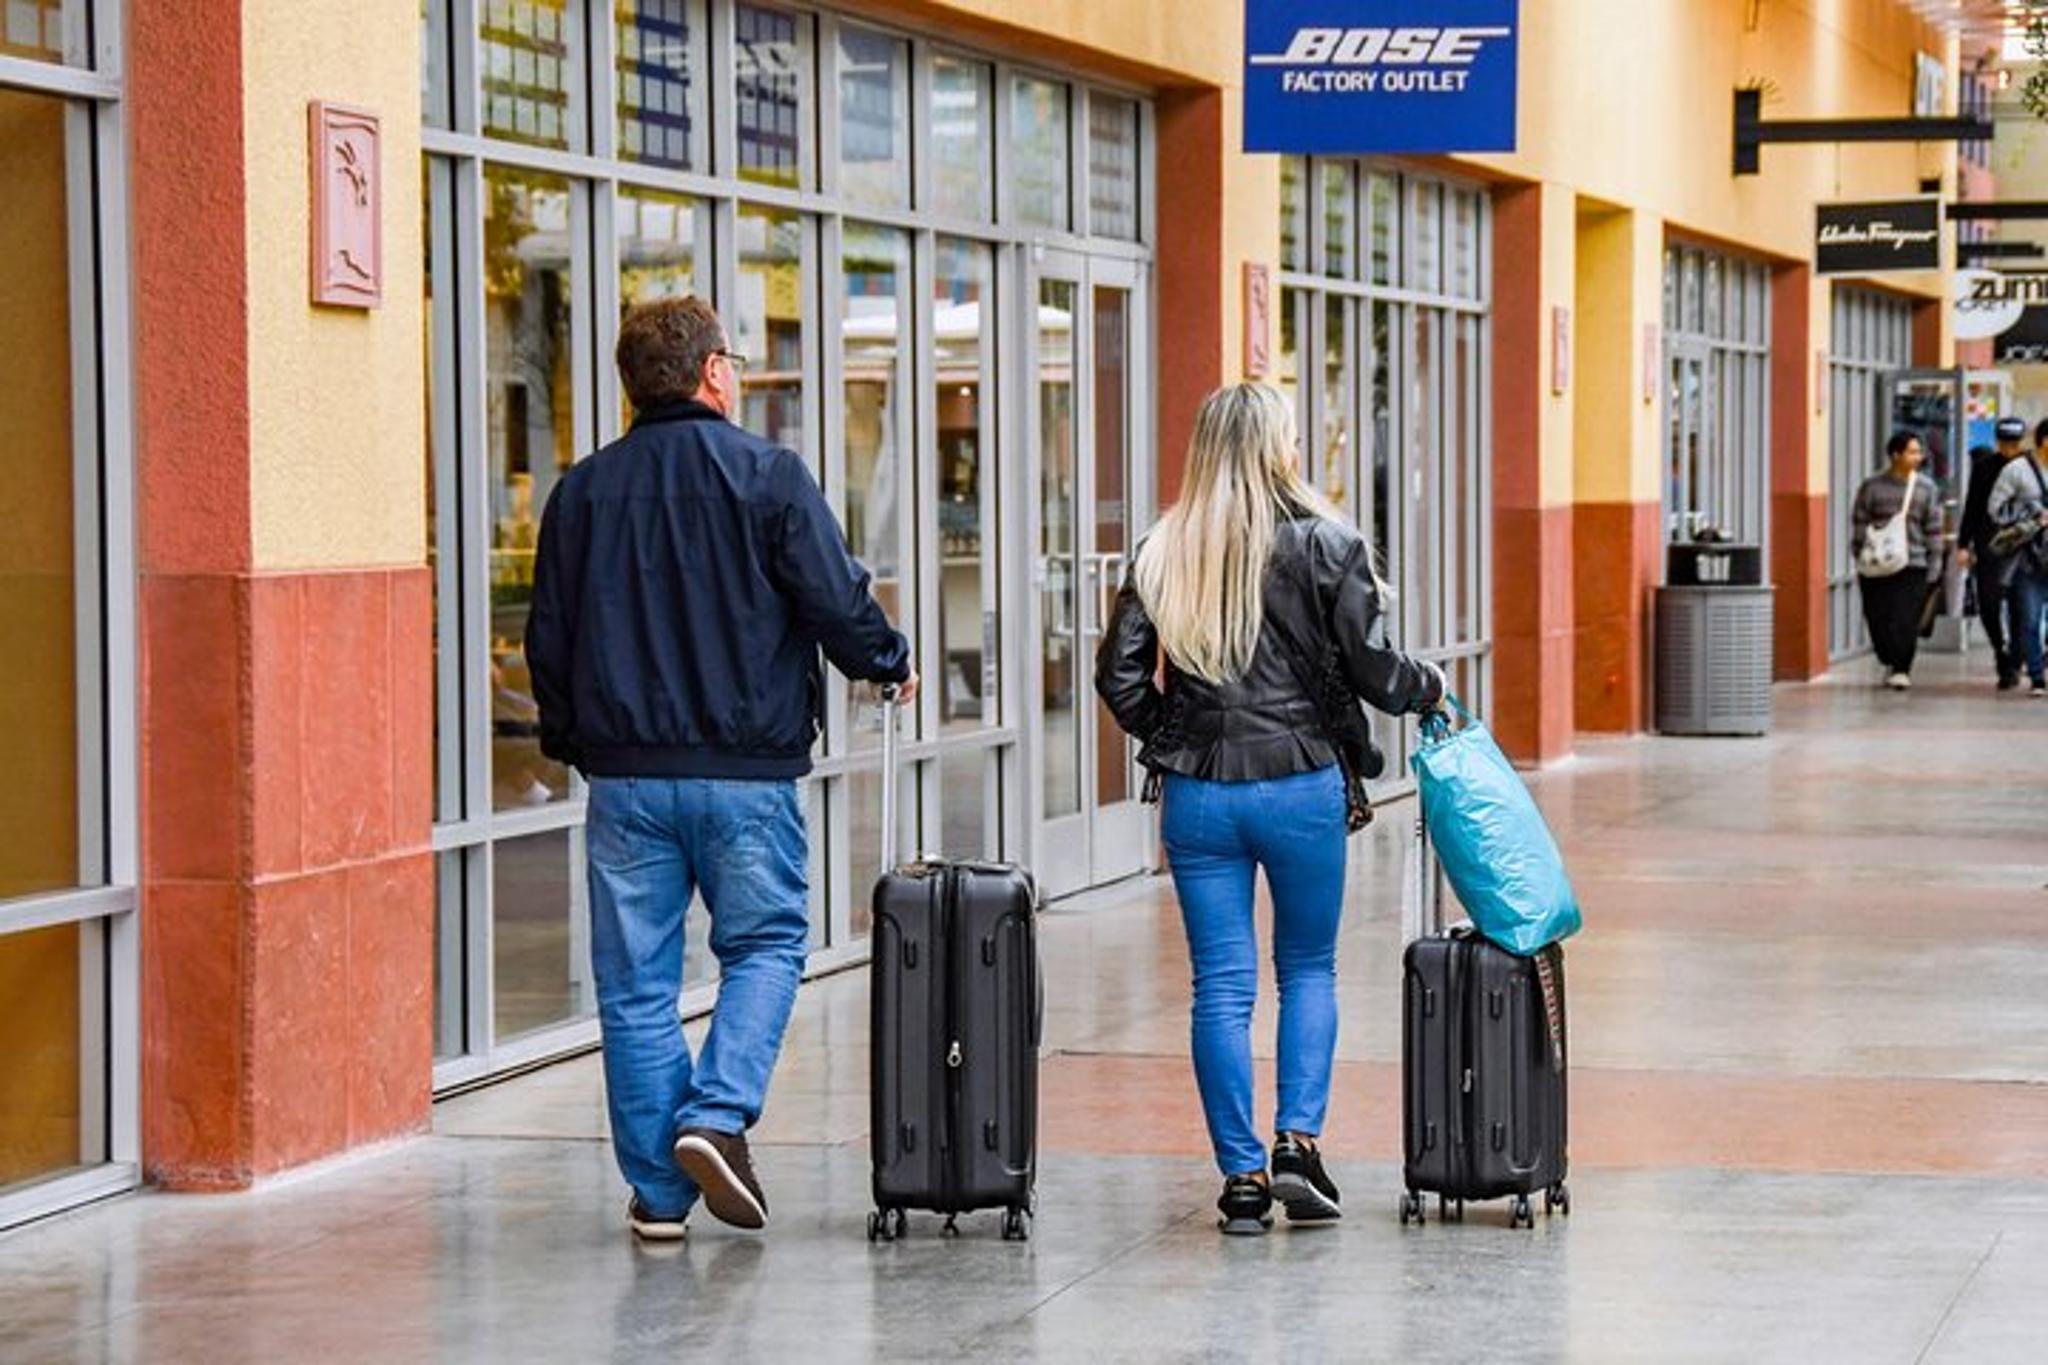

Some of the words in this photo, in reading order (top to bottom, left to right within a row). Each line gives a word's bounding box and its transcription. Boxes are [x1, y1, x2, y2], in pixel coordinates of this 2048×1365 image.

[1250, 27, 1511, 64] BOSE
[1282, 71, 1378, 91] FACTORY
[1382, 71, 1469, 91] OUTLET
[1971, 278, 2048, 300] zum
